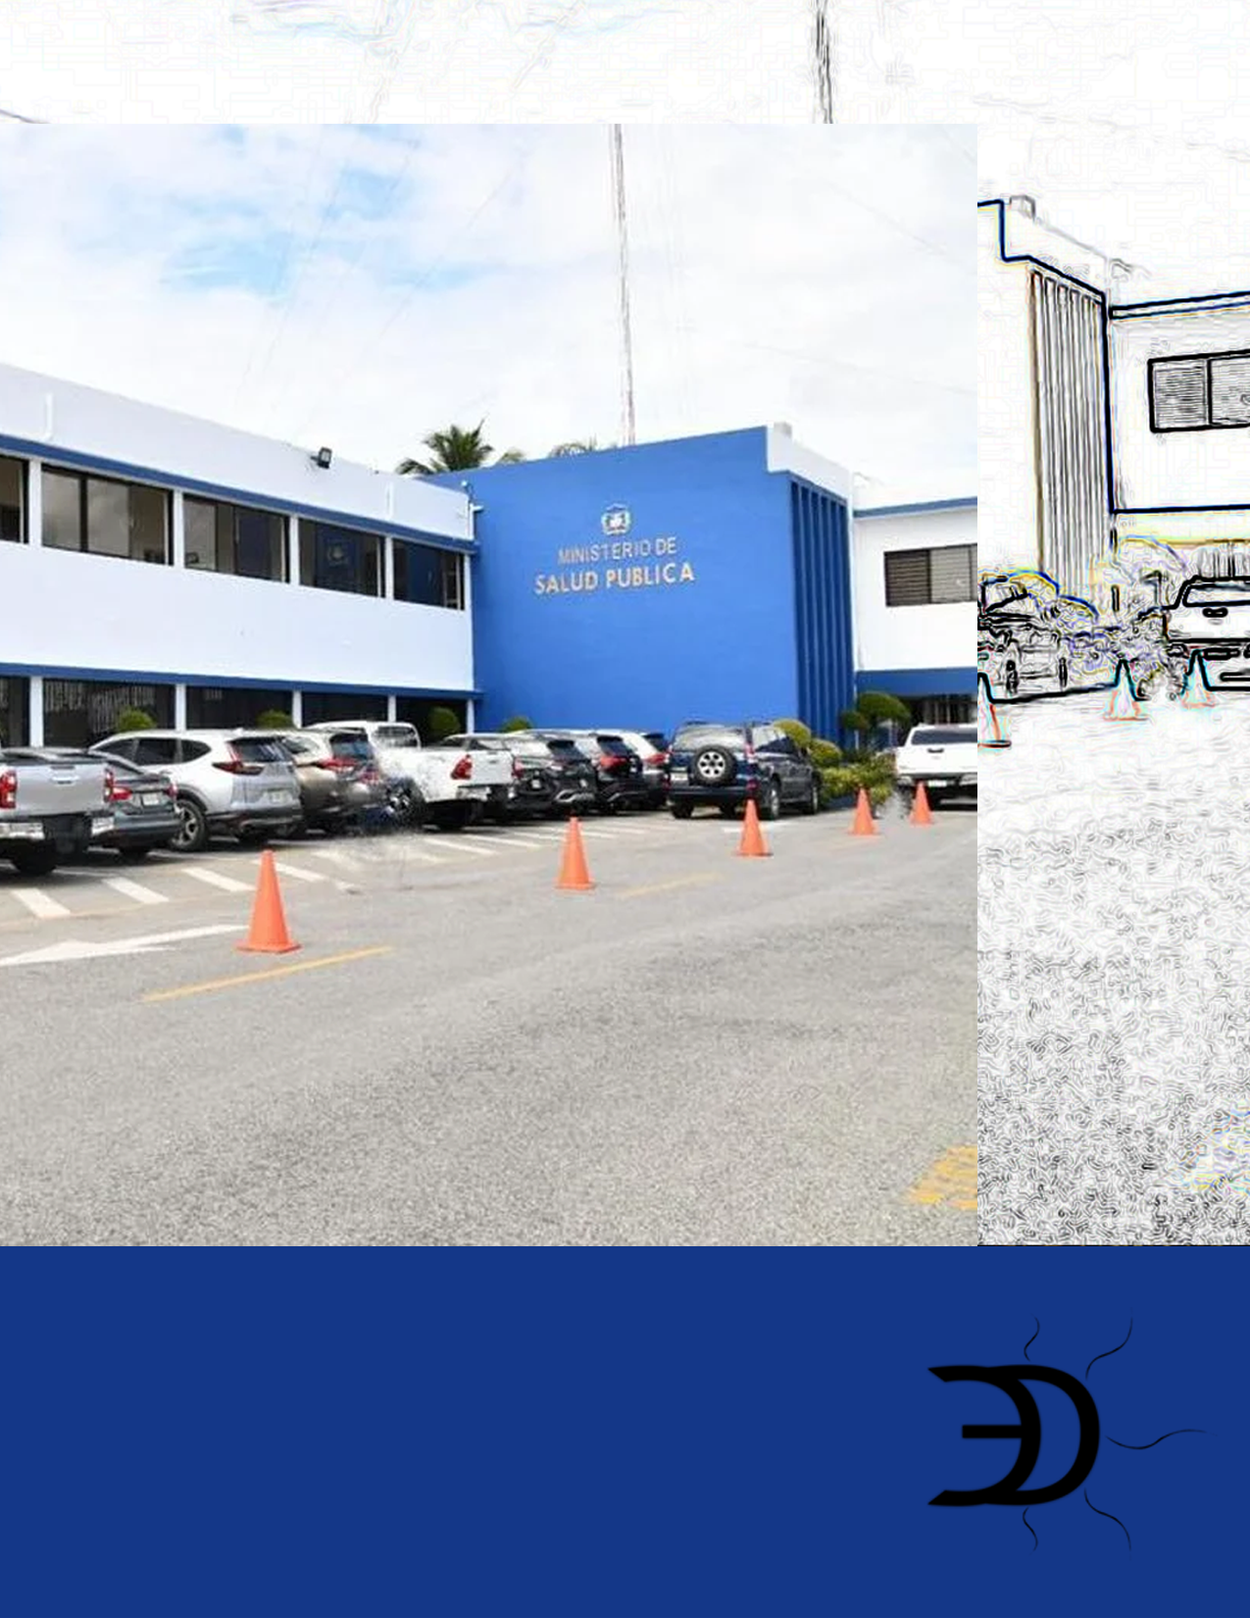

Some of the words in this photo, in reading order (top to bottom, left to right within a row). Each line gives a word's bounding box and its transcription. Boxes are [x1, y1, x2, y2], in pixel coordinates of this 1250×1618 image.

[558, 540, 651, 564] MINISTERIO
[655, 537, 677, 556] DE
[534, 571, 598, 595] SALUD
[606, 562, 695, 588] PUBLICA
